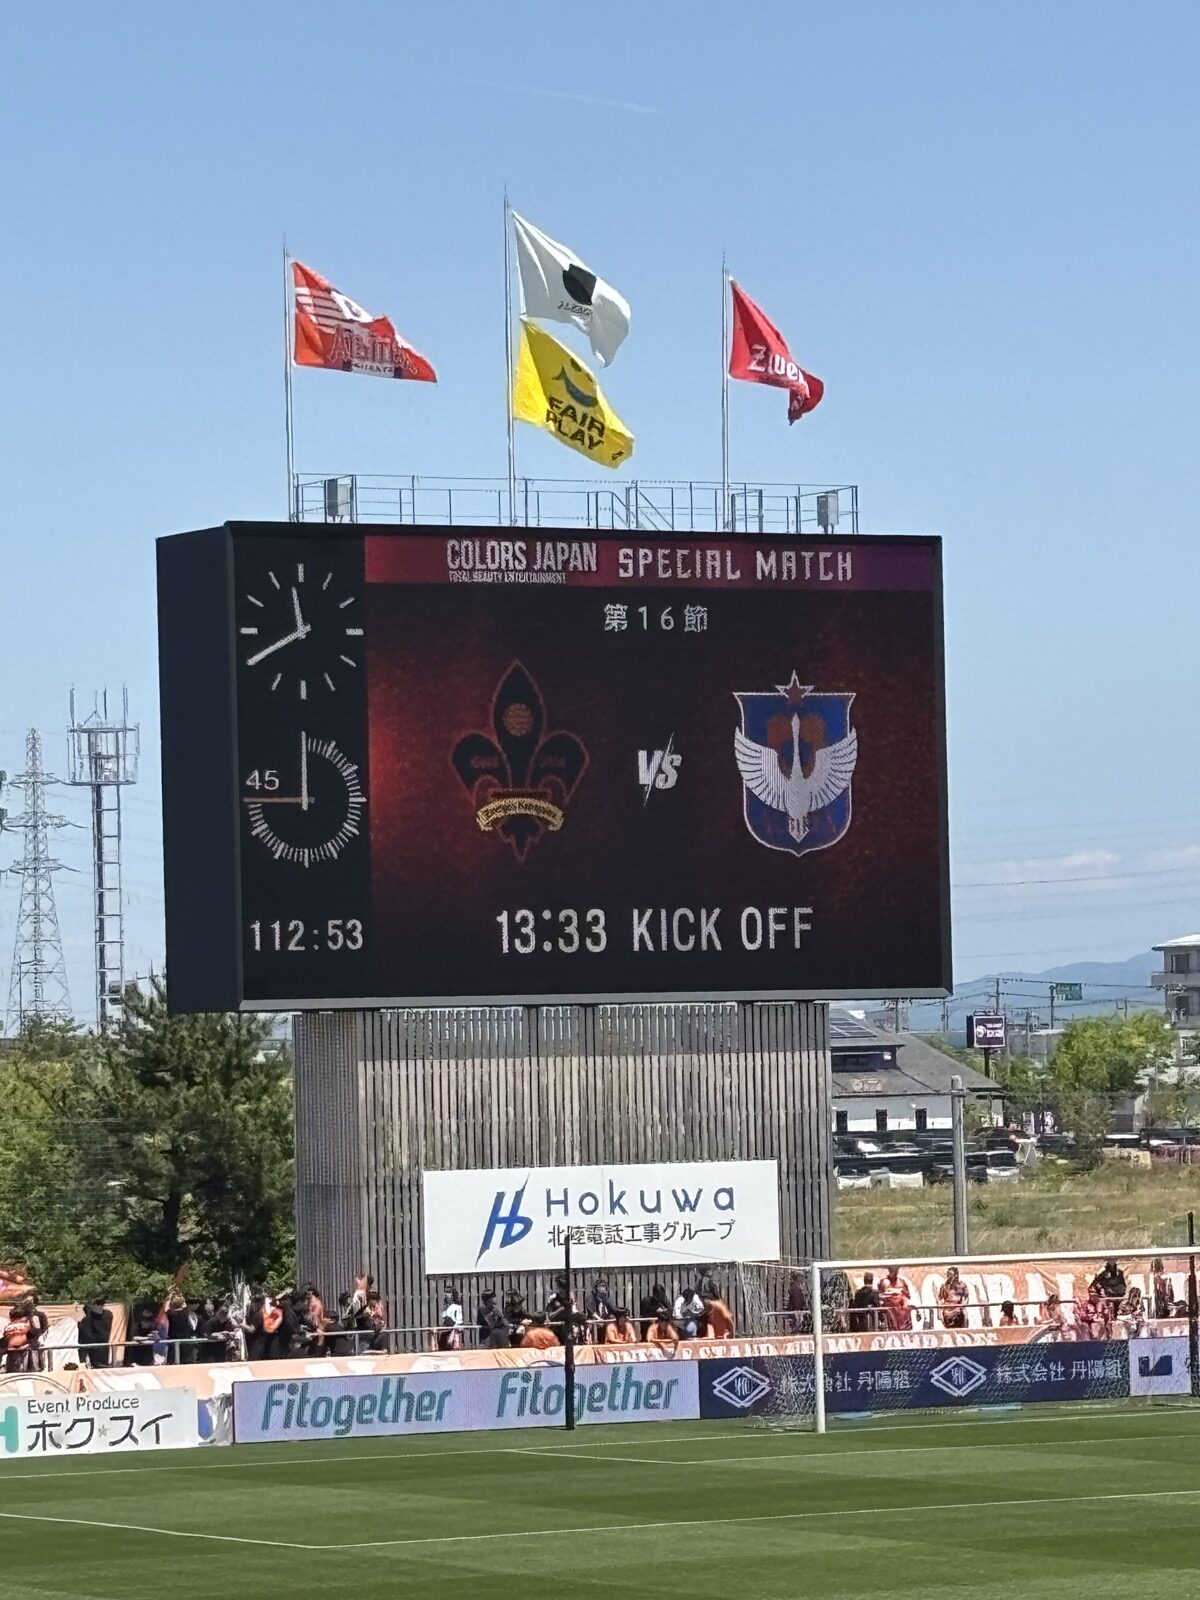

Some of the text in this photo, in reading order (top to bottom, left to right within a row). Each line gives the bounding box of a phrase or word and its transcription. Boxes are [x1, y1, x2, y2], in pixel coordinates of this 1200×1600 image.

[545, 408, 604, 450] PLAY
[547, 396, 605, 438] FAIR
[446, 539, 853, 581] COLORS JAPAN SPECIAL MATCH
[604, 602, 708, 633] 第16節
[245, 769, 280, 791] 45
[637, 742, 682, 798] VS
[250, 918, 364, 952] 112:53
[497, 906, 814, 954] 13:33 KICK OFF
[546, 1179, 735, 1217] Hokuwa
[826, 1337, 862, 1353] MY
[27, 1396, 140, 1413] Event Produce
[261, 1376, 452, 1436] Fitogether
[496, 1365, 679, 1424] Fitogether
